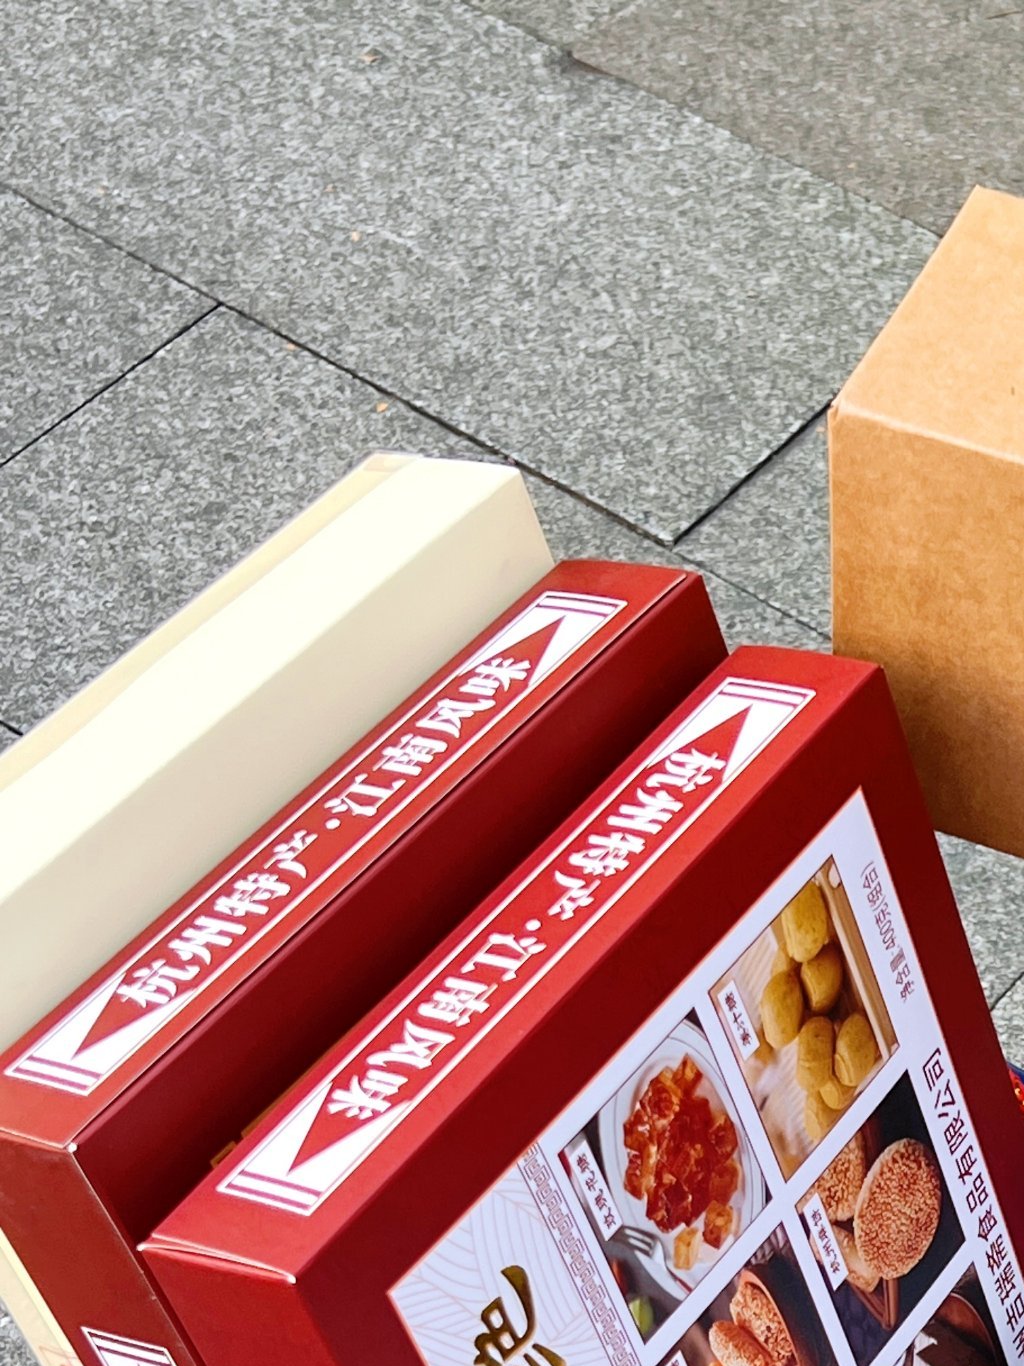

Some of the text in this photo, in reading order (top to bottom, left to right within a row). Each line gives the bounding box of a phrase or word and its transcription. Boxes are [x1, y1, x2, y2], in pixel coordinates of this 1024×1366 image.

[116, 656, 531, 1008] 杭州特产·江南风味
[329, 748, 727, 1121] 杭州特产·江南风味
